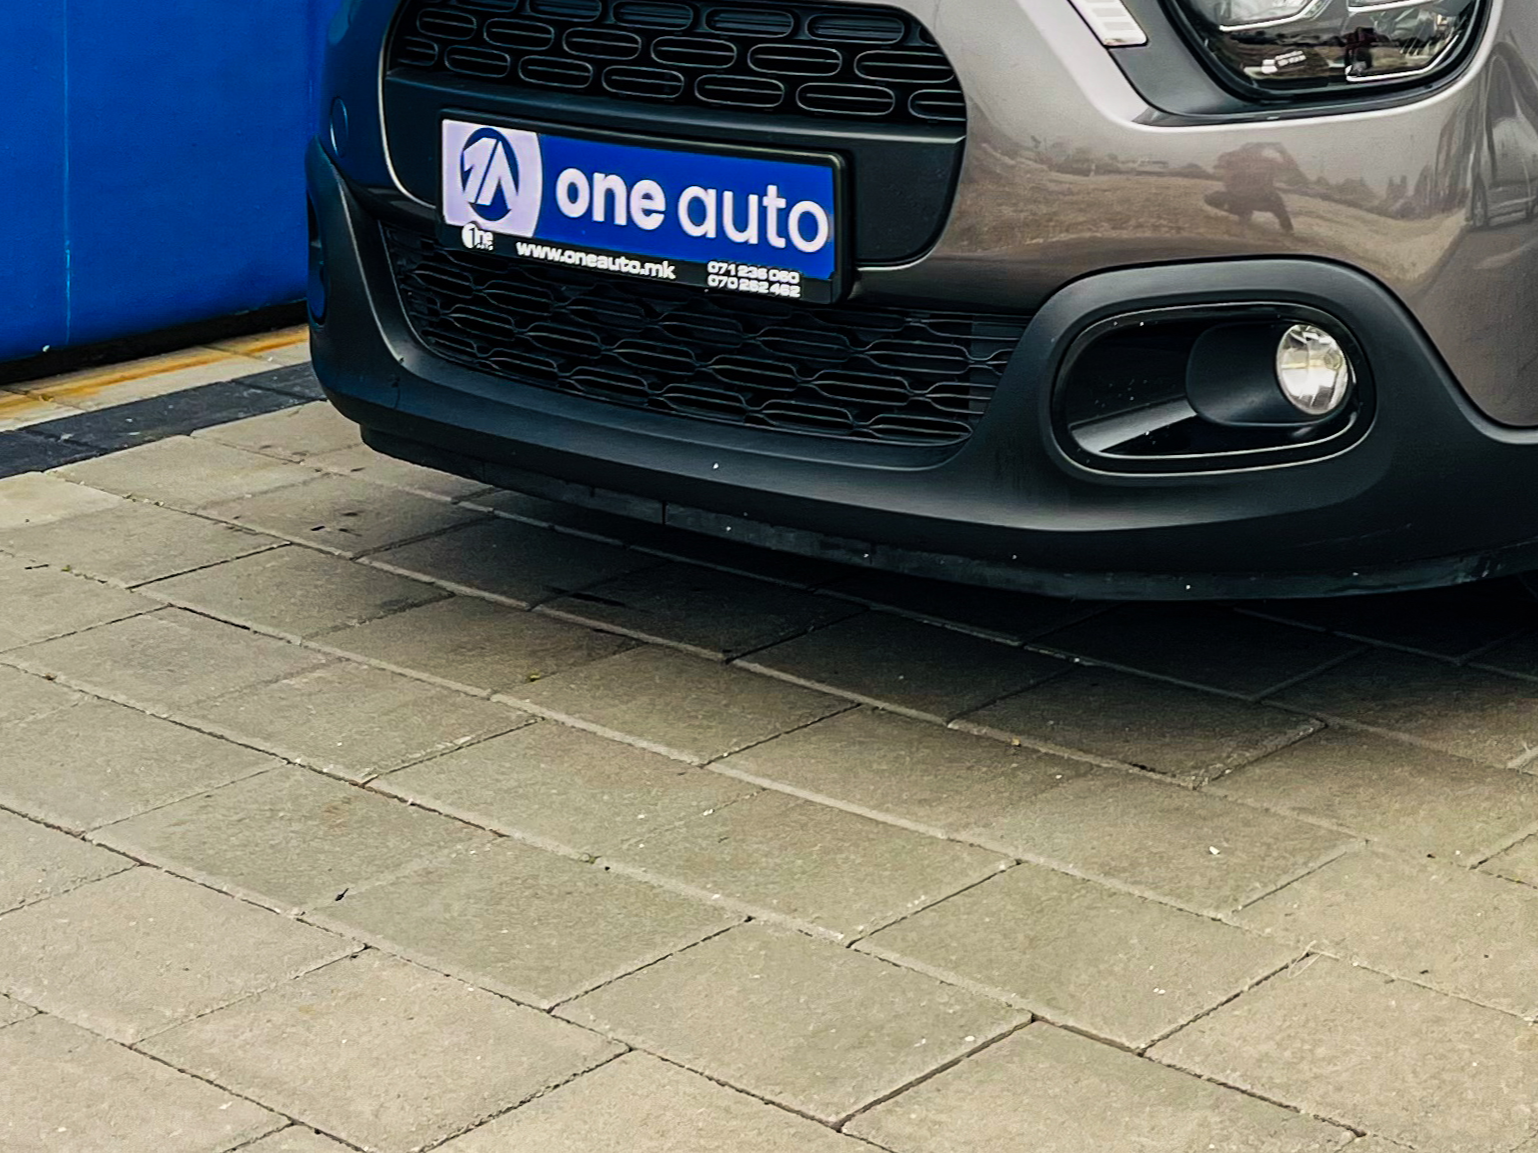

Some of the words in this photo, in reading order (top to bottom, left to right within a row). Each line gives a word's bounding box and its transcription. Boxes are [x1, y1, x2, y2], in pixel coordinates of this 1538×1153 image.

[555, 167, 666, 231] one
[677, 184, 830, 254] auto
[516, 241, 677, 281] www.oneauto.mk
[707, 260, 737, 276] 071
[707, 274, 738, 289] 070
